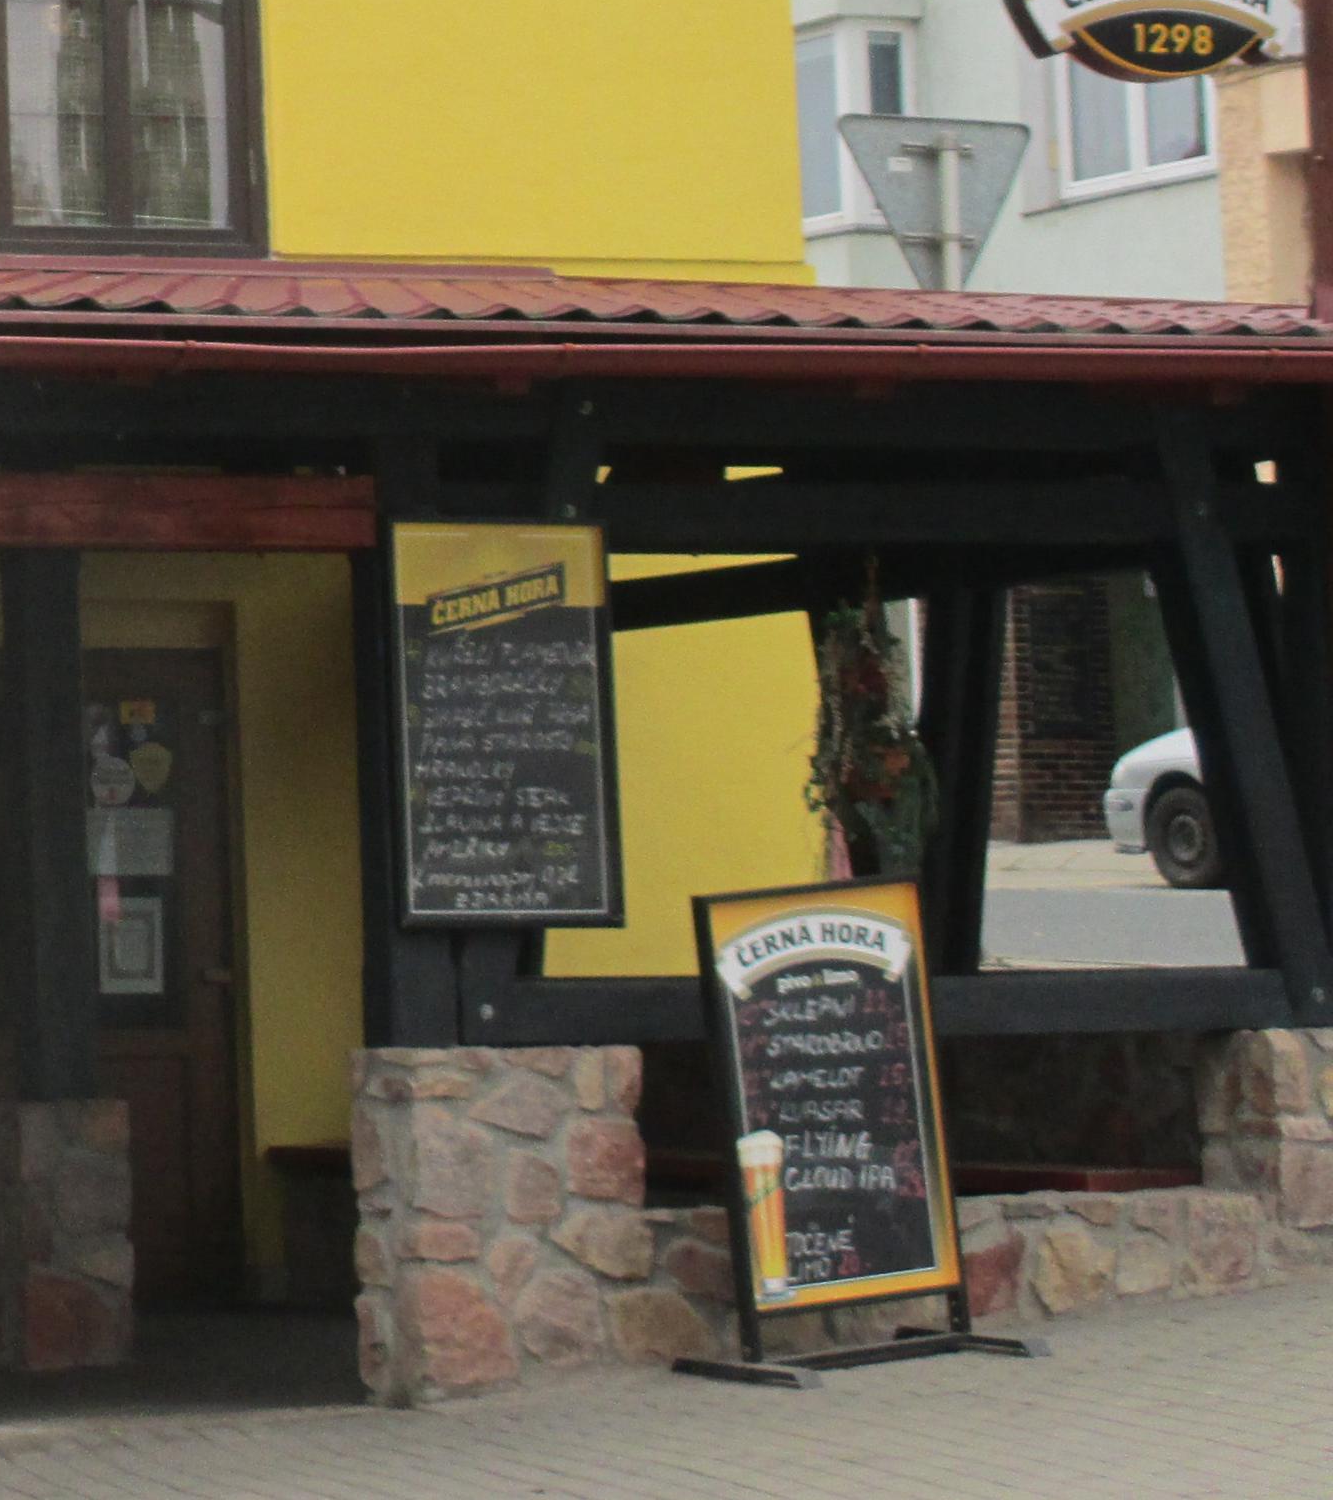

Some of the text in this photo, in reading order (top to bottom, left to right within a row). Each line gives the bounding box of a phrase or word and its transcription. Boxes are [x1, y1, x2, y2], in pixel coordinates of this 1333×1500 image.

[1133, 22, 1215, 55] 1298
[431, 573, 560, 627] ČERNÁ HORA
[736, 921, 886, 968] ČERNÁ HORA
